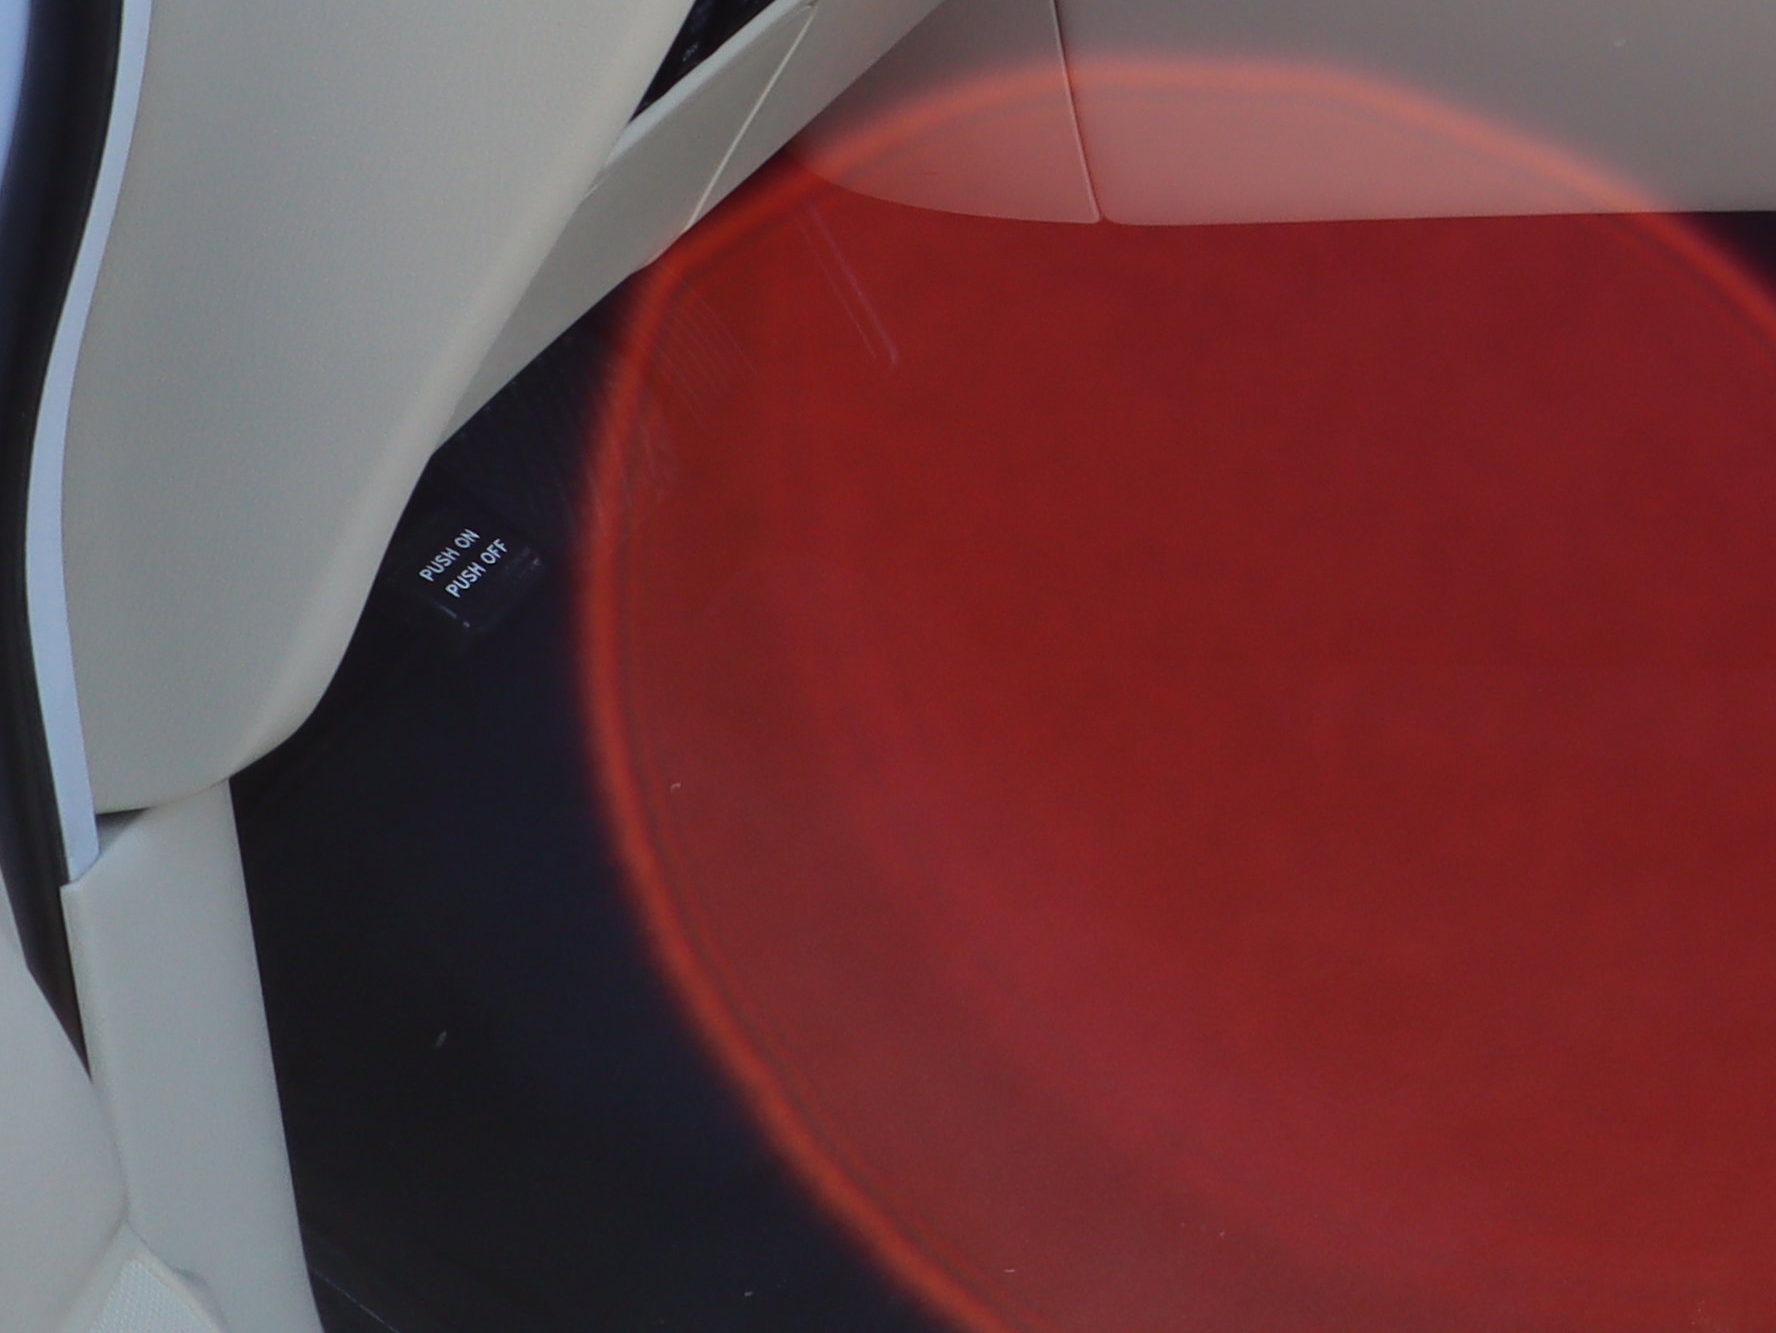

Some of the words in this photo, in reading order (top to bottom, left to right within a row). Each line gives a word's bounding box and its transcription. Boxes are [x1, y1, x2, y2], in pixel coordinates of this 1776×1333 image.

[419, 546, 460, 582] PUSH
[454, 528, 481, 549] ON
[445, 562, 486, 598] PUSH
[480, 538, 509, 565] OFF
